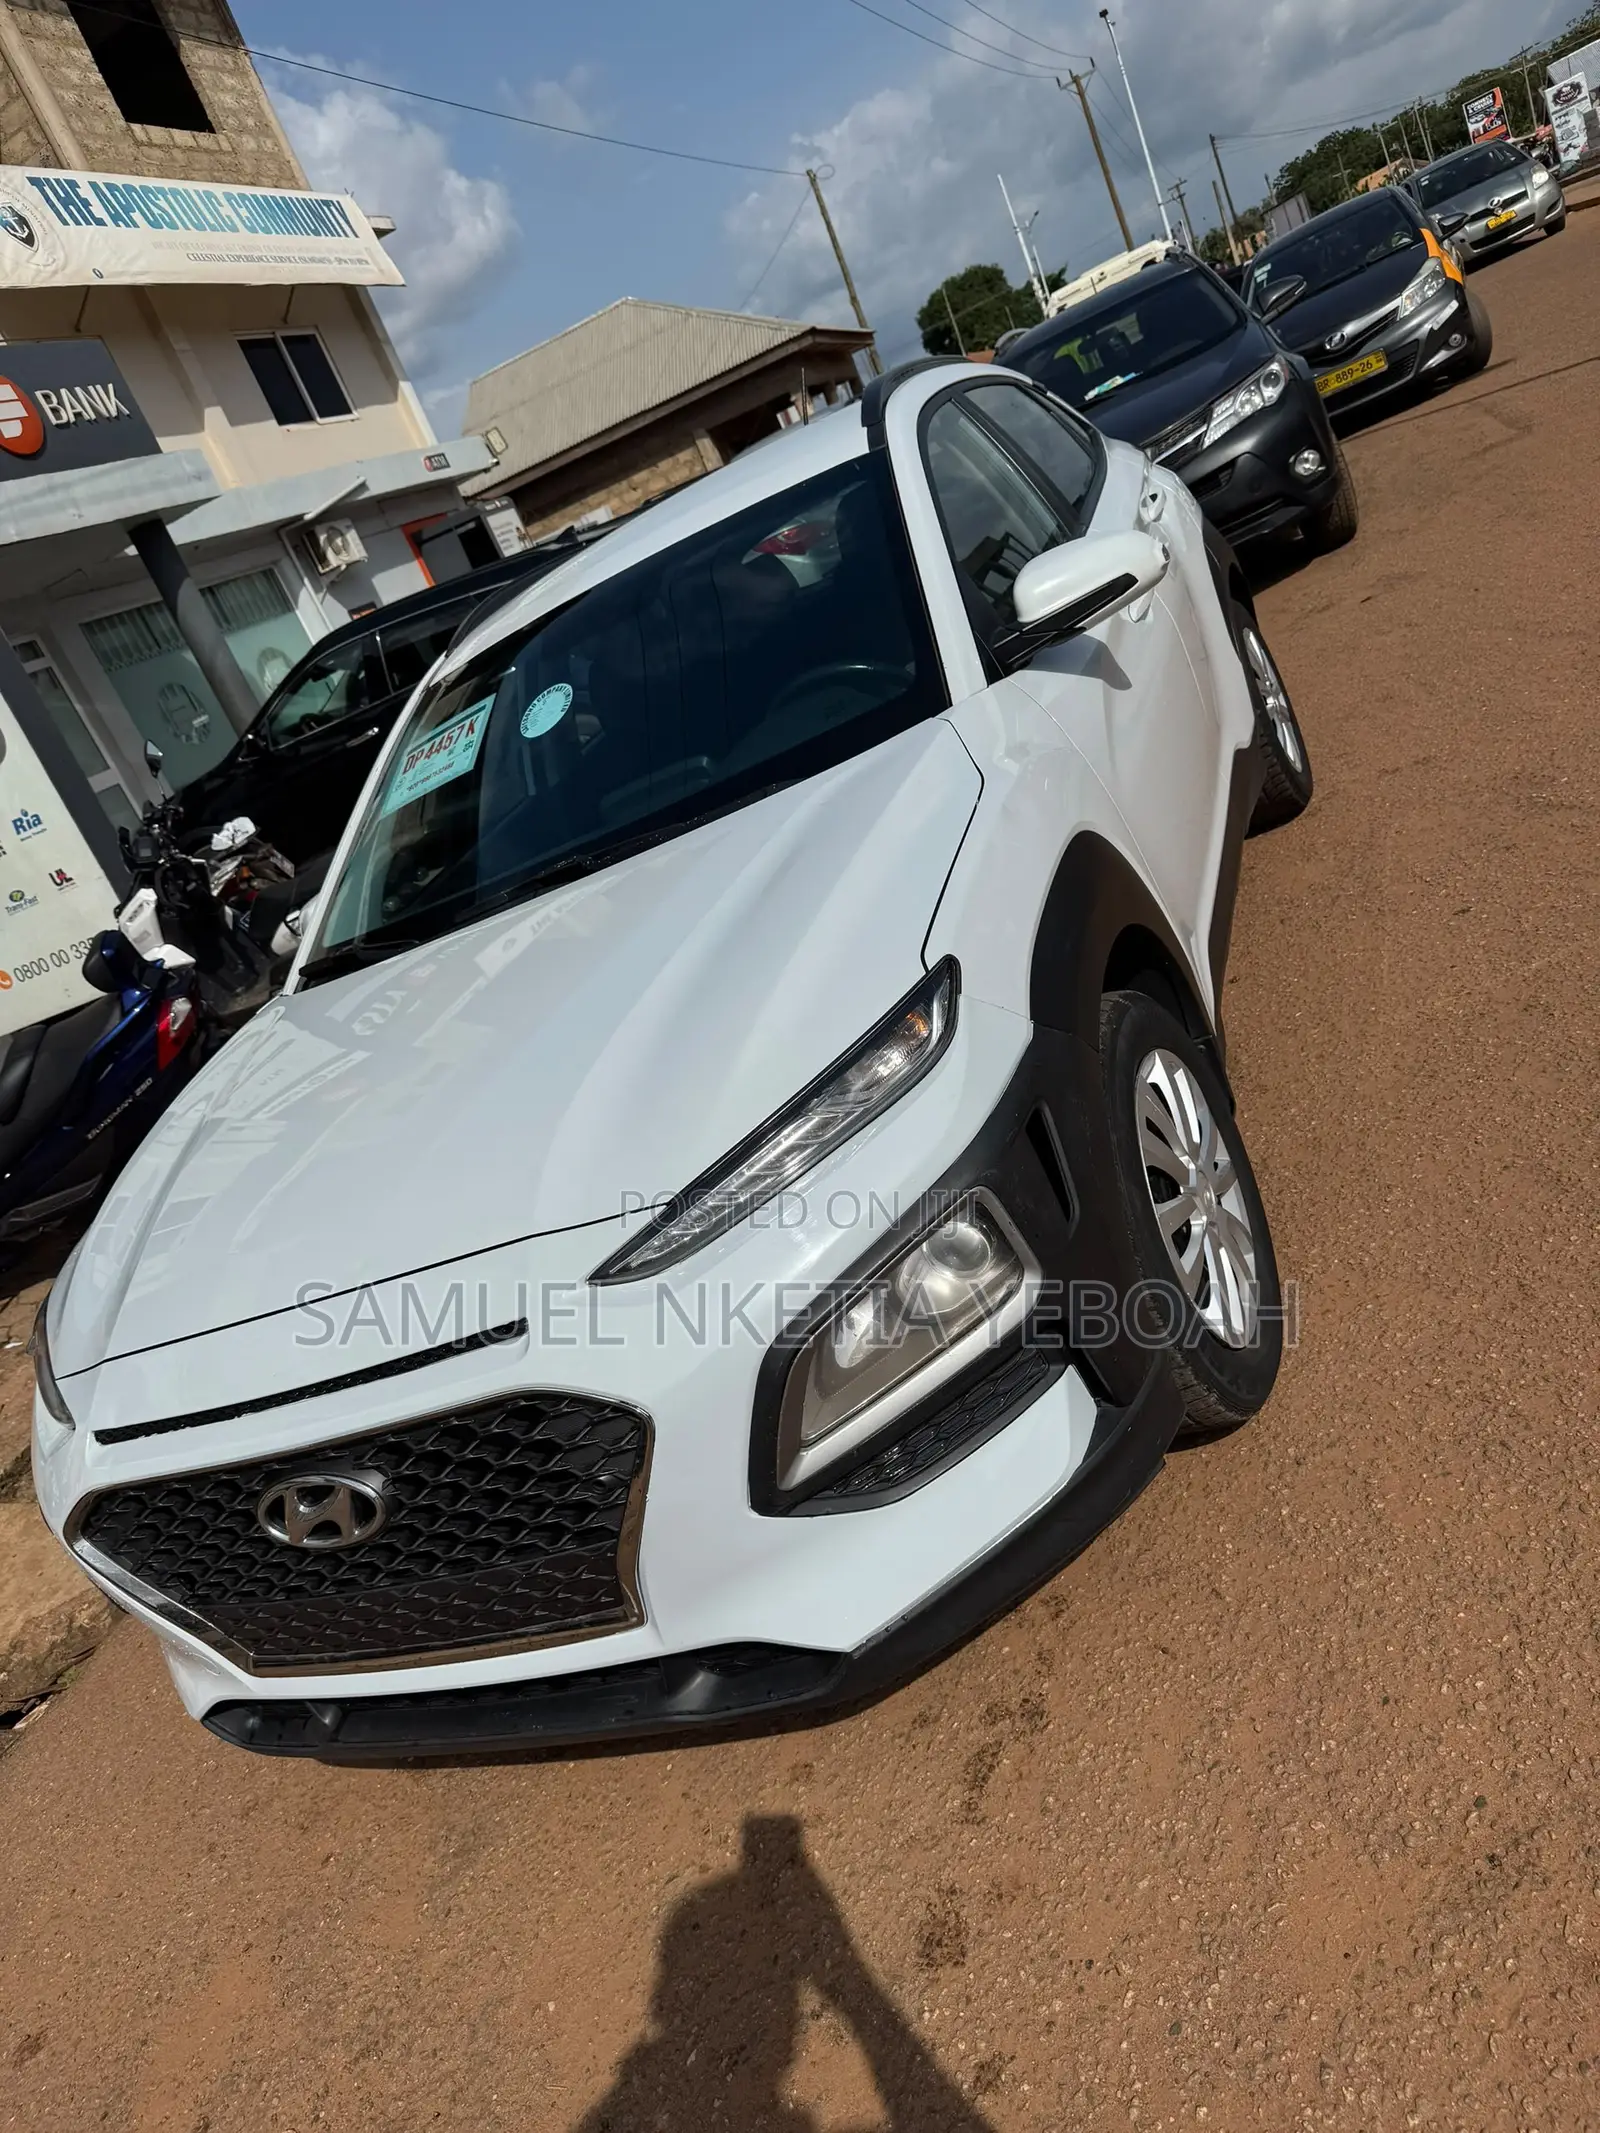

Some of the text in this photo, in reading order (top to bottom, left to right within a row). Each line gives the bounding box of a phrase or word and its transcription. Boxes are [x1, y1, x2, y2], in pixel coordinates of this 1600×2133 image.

[25, 176, 108, 227] THE
[88, 181, 239, 232] APOSTOLIC
[222, 192, 360, 239] COMMUNITY
[186, 252, 228, 262] CELESTIAL
[1316, 360, 1373, 392] BR 889-26
[34, 383, 130, 426] BANK
[431, 454, 449, 470] ATM
[402, 748, 426, 775] DP
[424, 723, 467, 760] 4457
[465, 715, 480, 738] K
[12, 809, 43, 835] Ria
[13, 957, 50, 983] 0800
[50, 949, 70, 968] 00
